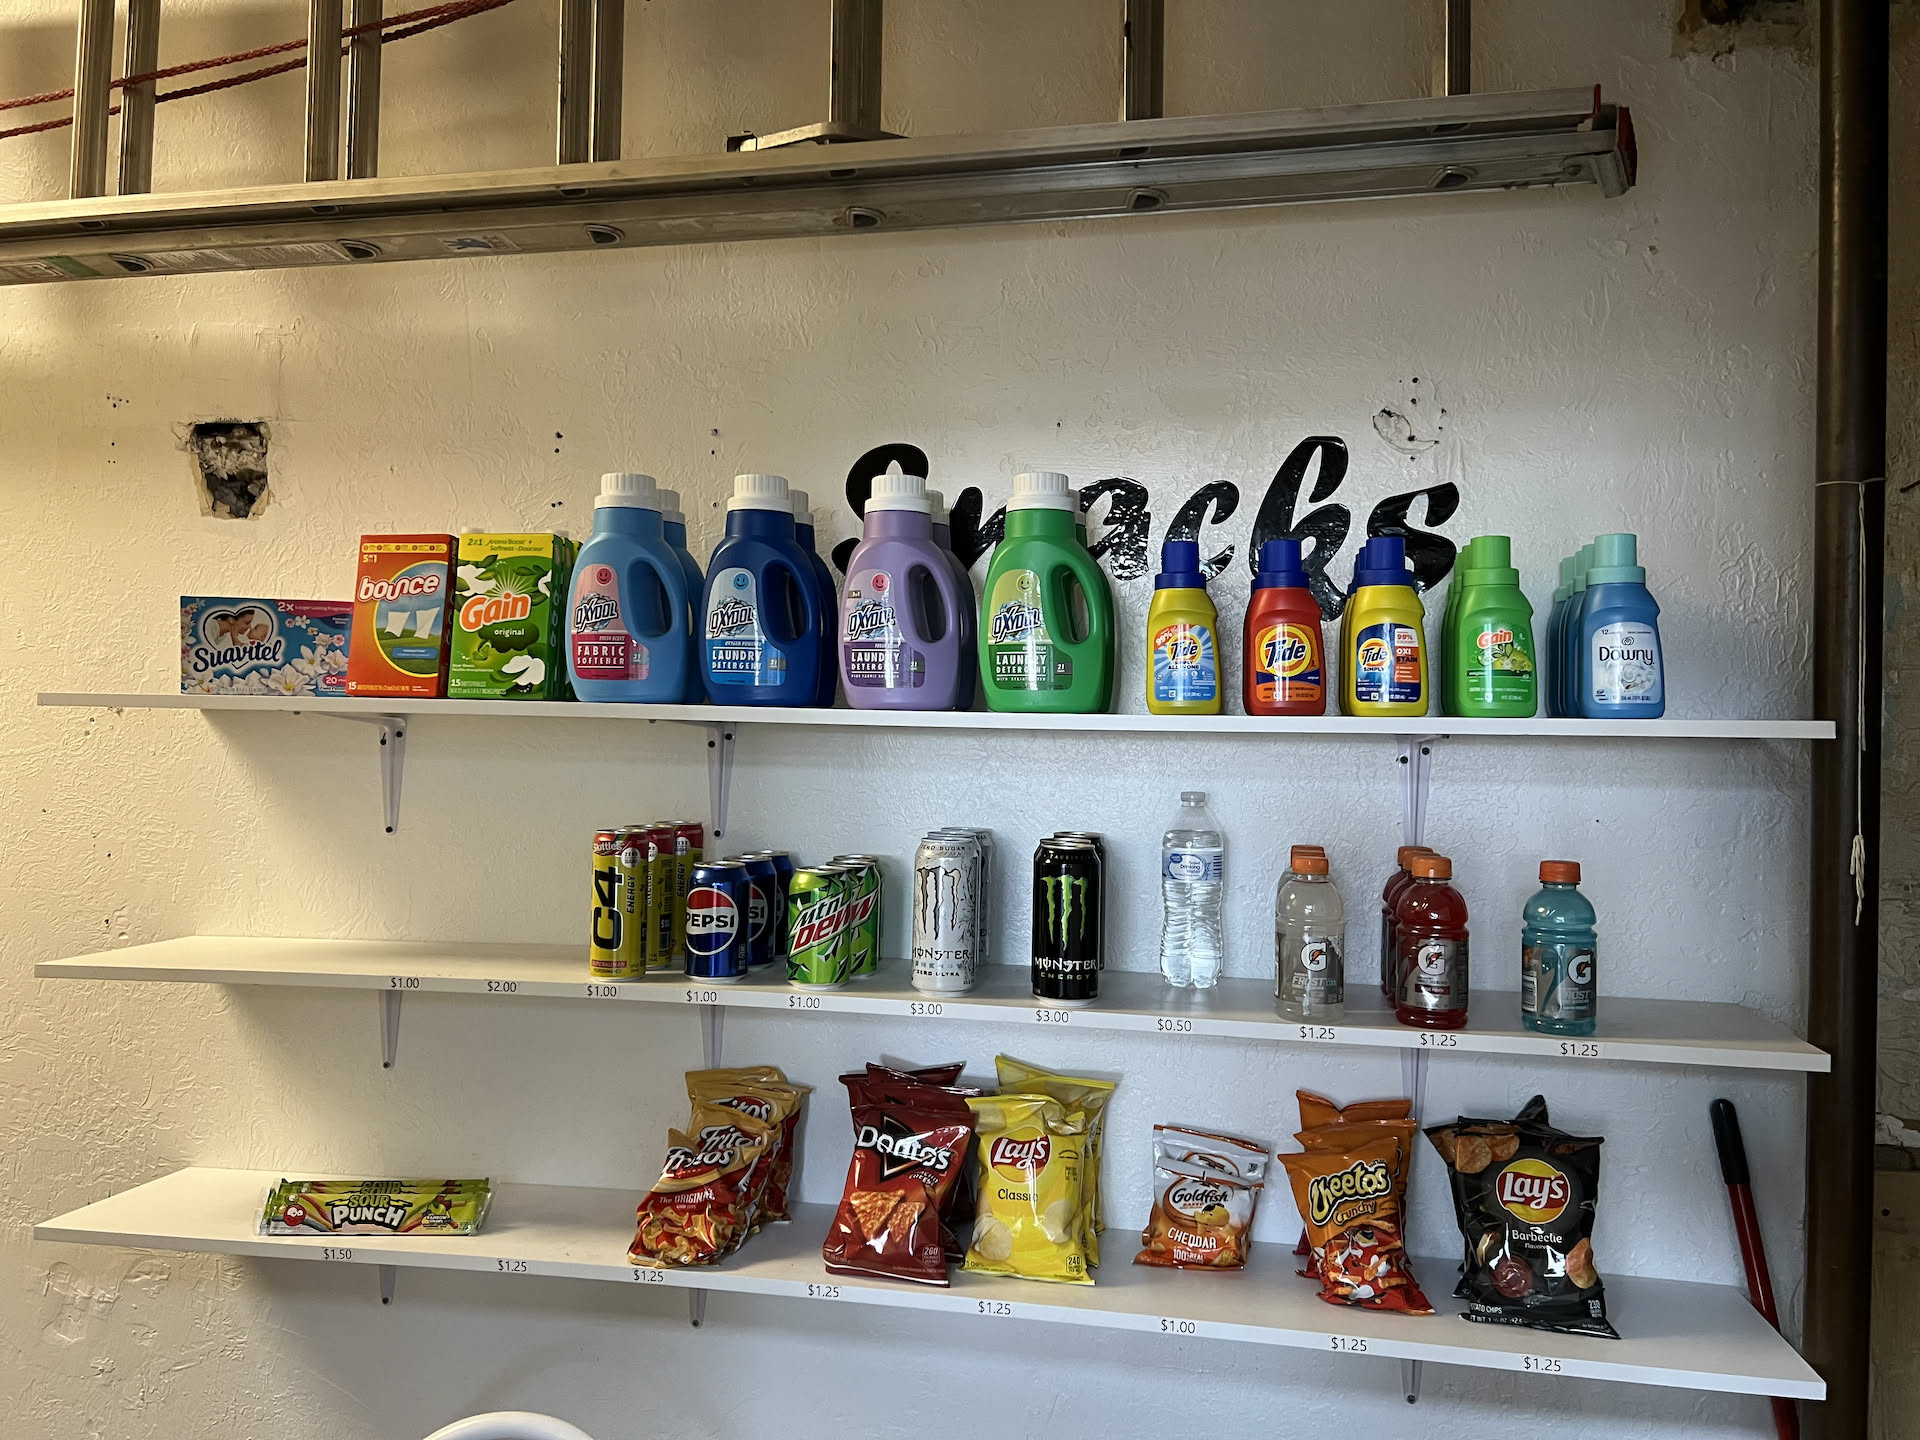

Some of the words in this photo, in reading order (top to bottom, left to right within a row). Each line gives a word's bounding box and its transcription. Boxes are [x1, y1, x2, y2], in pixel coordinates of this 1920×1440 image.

[358, 575, 440, 602] bounce
[461, 592, 531, 632] Gain
[494, 628, 525, 637] original
[1477, 629, 1513, 649] Gain
[193, 639, 282, 673] Suavitel
[577, 646, 625, 656] FABRIC
[712, 650, 762, 660] LAUNDRY
[851, 652, 900, 662] LAUNDY
[1170, 641, 1199, 661] Tide
[1264, 638, 1307, 669] Tide
[1363, 647, 1388, 666] Tide
[1599, 646, 1655, 666] Downy
[851, 663, 900, 671] DETERGT
[996, 655, 1047, 665] LAUNRY
[996, 666, 1047, 674] DETERGNT
[348, 682, 357, 690] 15
[626, 875, 636, 914] ENERGY
[593, 867, 624, 951] C4
[686, 915, 735, 928] PEPSI
[1034, 957, 1097, 971] MONSTER
[1301, 942, 1327, 972] G
[1417, 945, 1445, 976] G
[1040, 972, 1090, 980] ENERGY
[1568, 953, 1592, 985] G
[391, 978, 420, 989] $1.00
[487, 981, 517, 993] $2.00
[587, 985, 617, 998] $1.00
[686, 990, 717, 1003] $1.00
[789, 996, 820, 1009] $1.00
[911, 1003, 943, 1016] $3.00
[1036, 1010, 1069, 1023] $3.00
[1157, 1018, 1192, 1032] $0.50
[1300, 1027, 1335, 1040] $1.25
[1420, 1033, 1457, 1047] $1.25
[1560, 1043, 1599, 1057] $1.25
[857, 1126, 950, 1170] Doritos
[993, 1137, 1048, 1170] Lay's
[1172, 1188, 1229, 1204] Goldfish
[1311, 1165, 1390, 1222] Cheetos
[1503, 1172, 1565, 1210] Lay's
[349, 1195, 390, 1208] SOUR
[332, 1205, 405, 1227] PUNCH
[1333, 1199, 1377, 1226] Crunchy
[1168, 1227, 1217, 1249] CHEDDAR
[323, 1248, 352, 1260] $1.50
[498, 1260, 528, 1272] $1.25
[634, 1270, 664, 1282] $1.25
[808, 1284, 839, 1298] $1.25
[979, 1302, 1011, 1315] $1.25
[1161, 1319, 1196, 1334] $1.00
[1331, 1337, 1367, 1352] $1.25
[1524, 1356, 1562, 1372] $1.25
